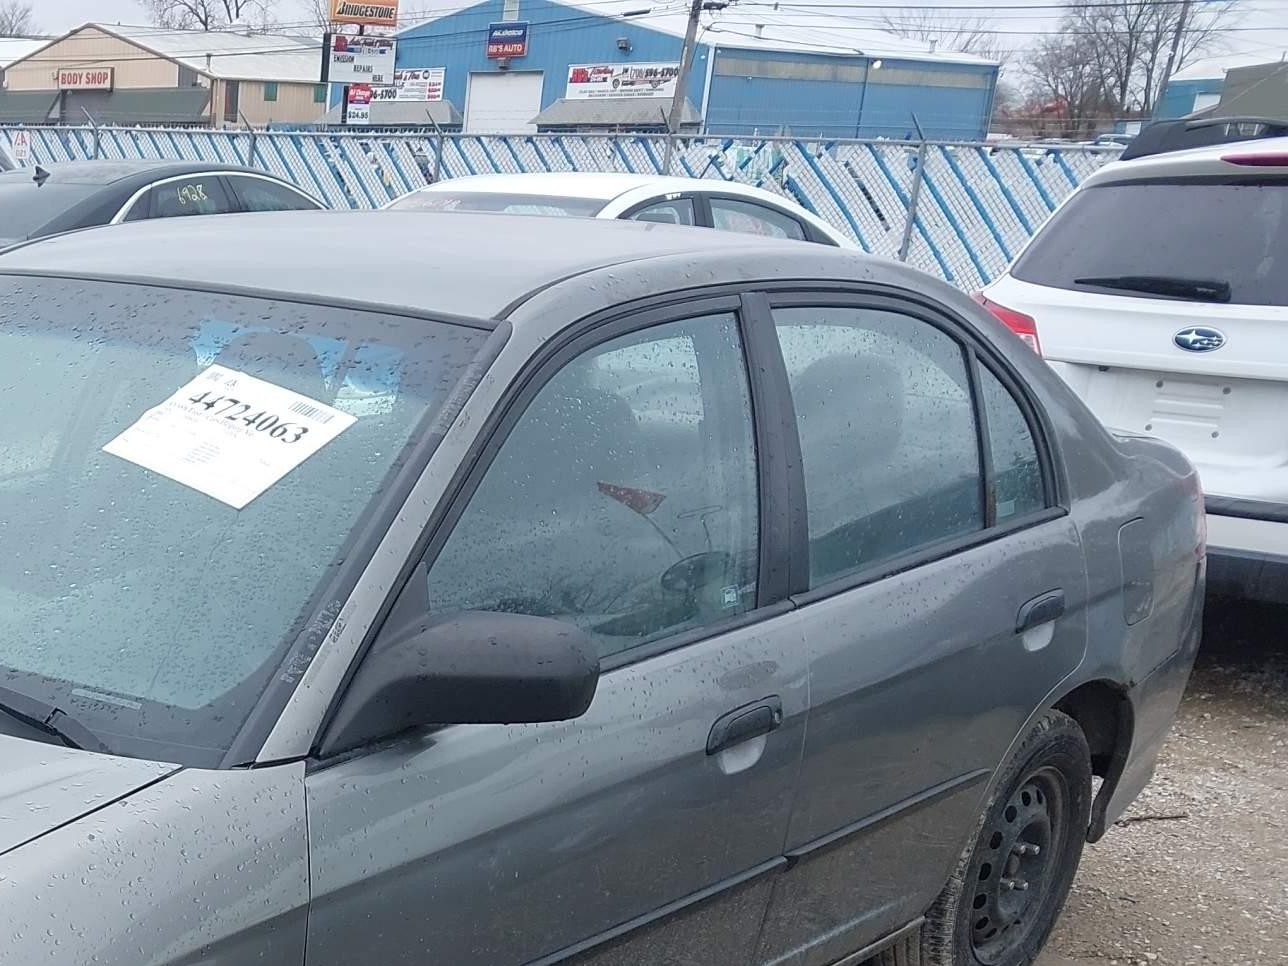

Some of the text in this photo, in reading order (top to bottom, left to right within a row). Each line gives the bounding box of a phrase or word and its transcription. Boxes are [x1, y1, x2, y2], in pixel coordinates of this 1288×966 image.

[336, 2, 395, 19] BRIDGESTONE
[503, 43, 523, 52] AUTO
[333, 54, 355, 63] EMISSION
[353, 64, 373, 73] REPAIRS
[60, 71, 109, 85] BODY SHOP
[187, 391, 309, 443] 44724063
